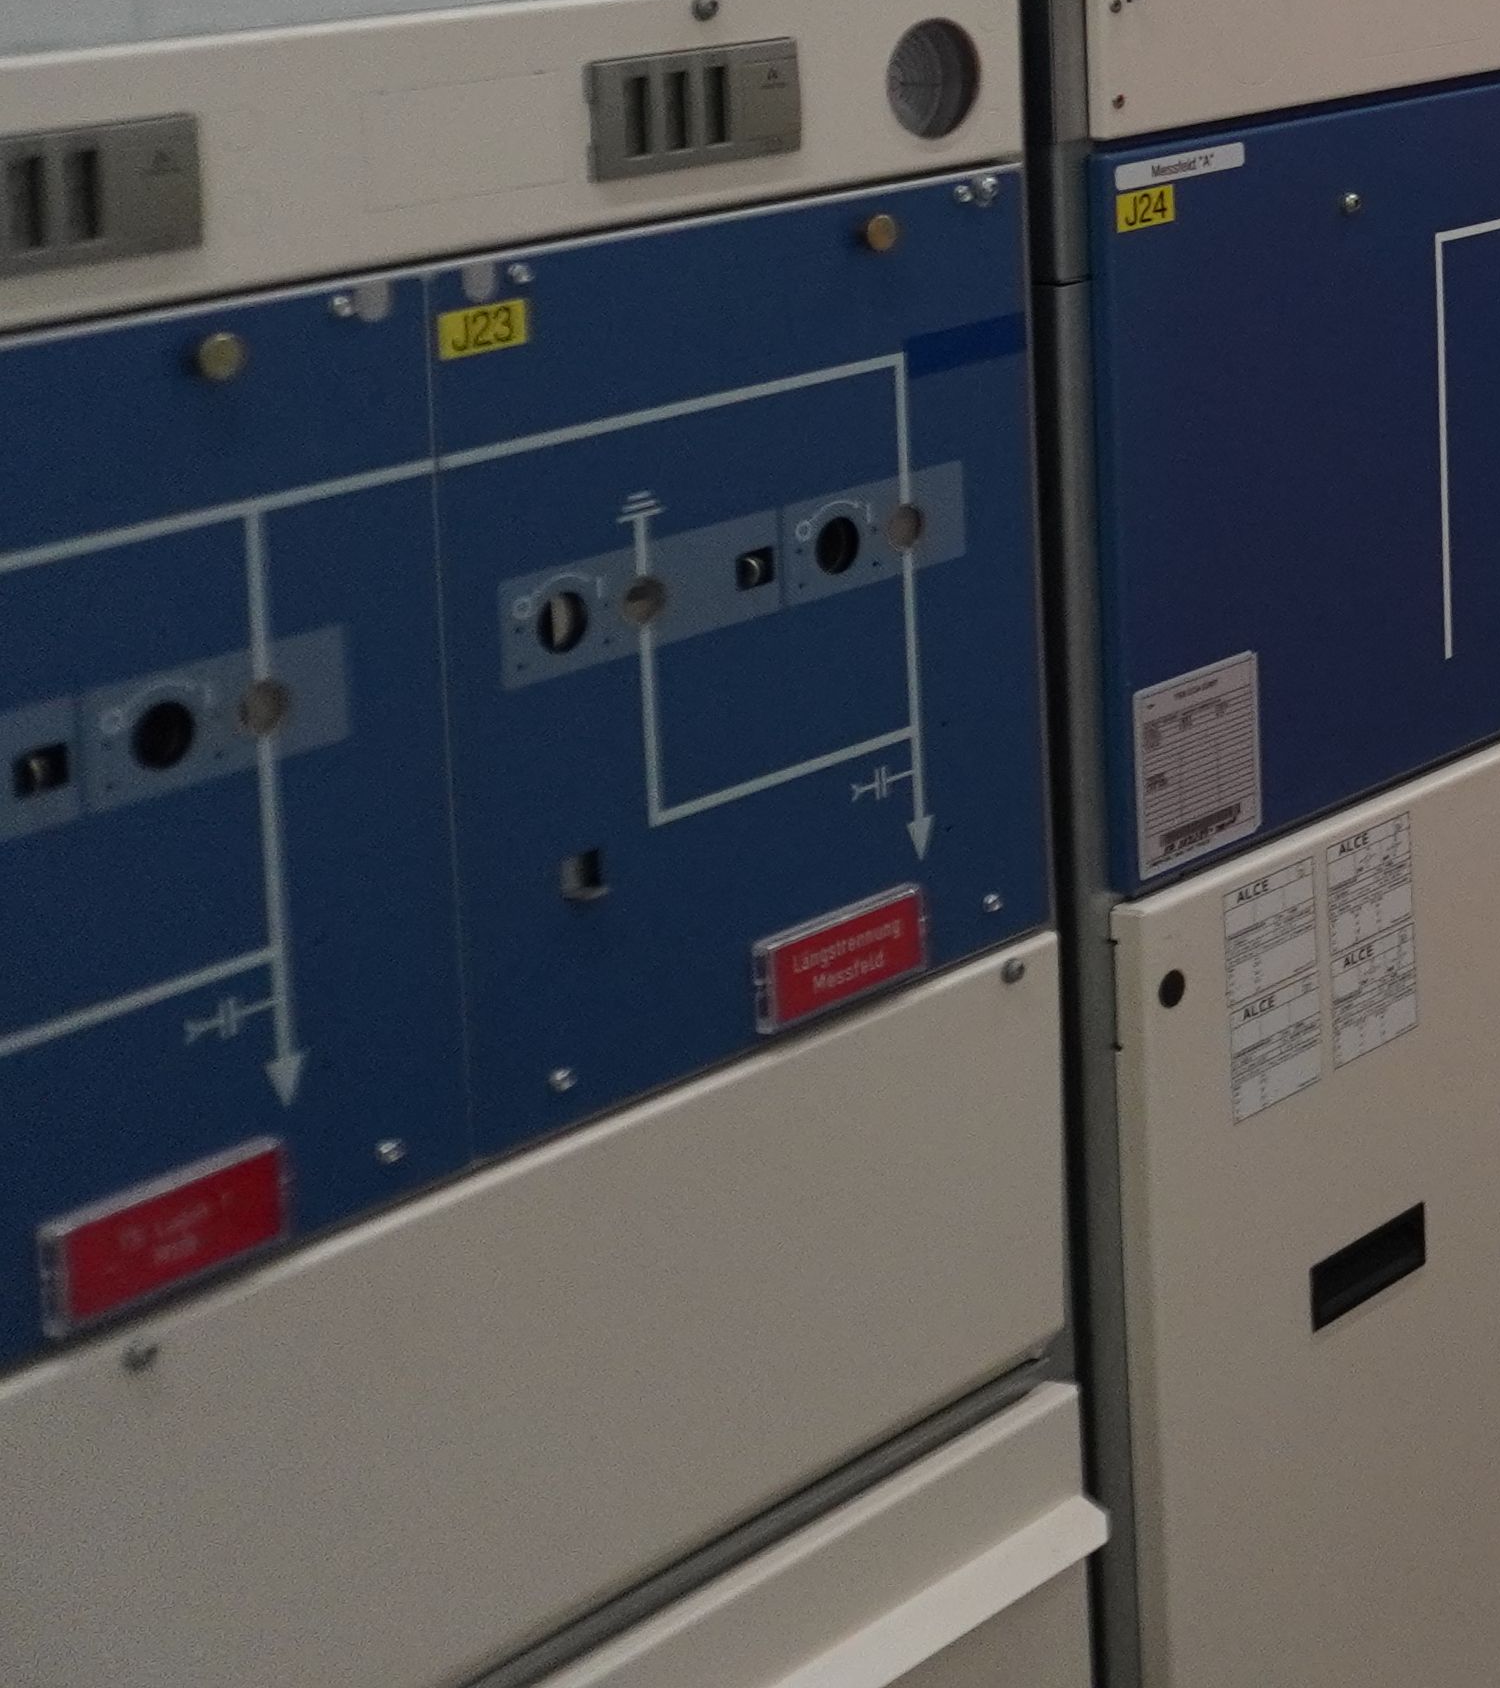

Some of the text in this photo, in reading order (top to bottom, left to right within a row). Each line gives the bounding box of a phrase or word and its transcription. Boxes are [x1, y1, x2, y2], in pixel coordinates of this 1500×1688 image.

[1151, 156, 1198, 178] Messfeld
[1124, 190, 1168, 227] J24
[451, 305, 515, 352] J23
[1338, 832, 1370, 857] ALCE
[1236, 879, 1270, 904] ALCE
[1343, 945, 1375, 969] ALCE
[812, 949, 885, 994] Messfeld
[1242, 995, 1275, 1021] ALCE
